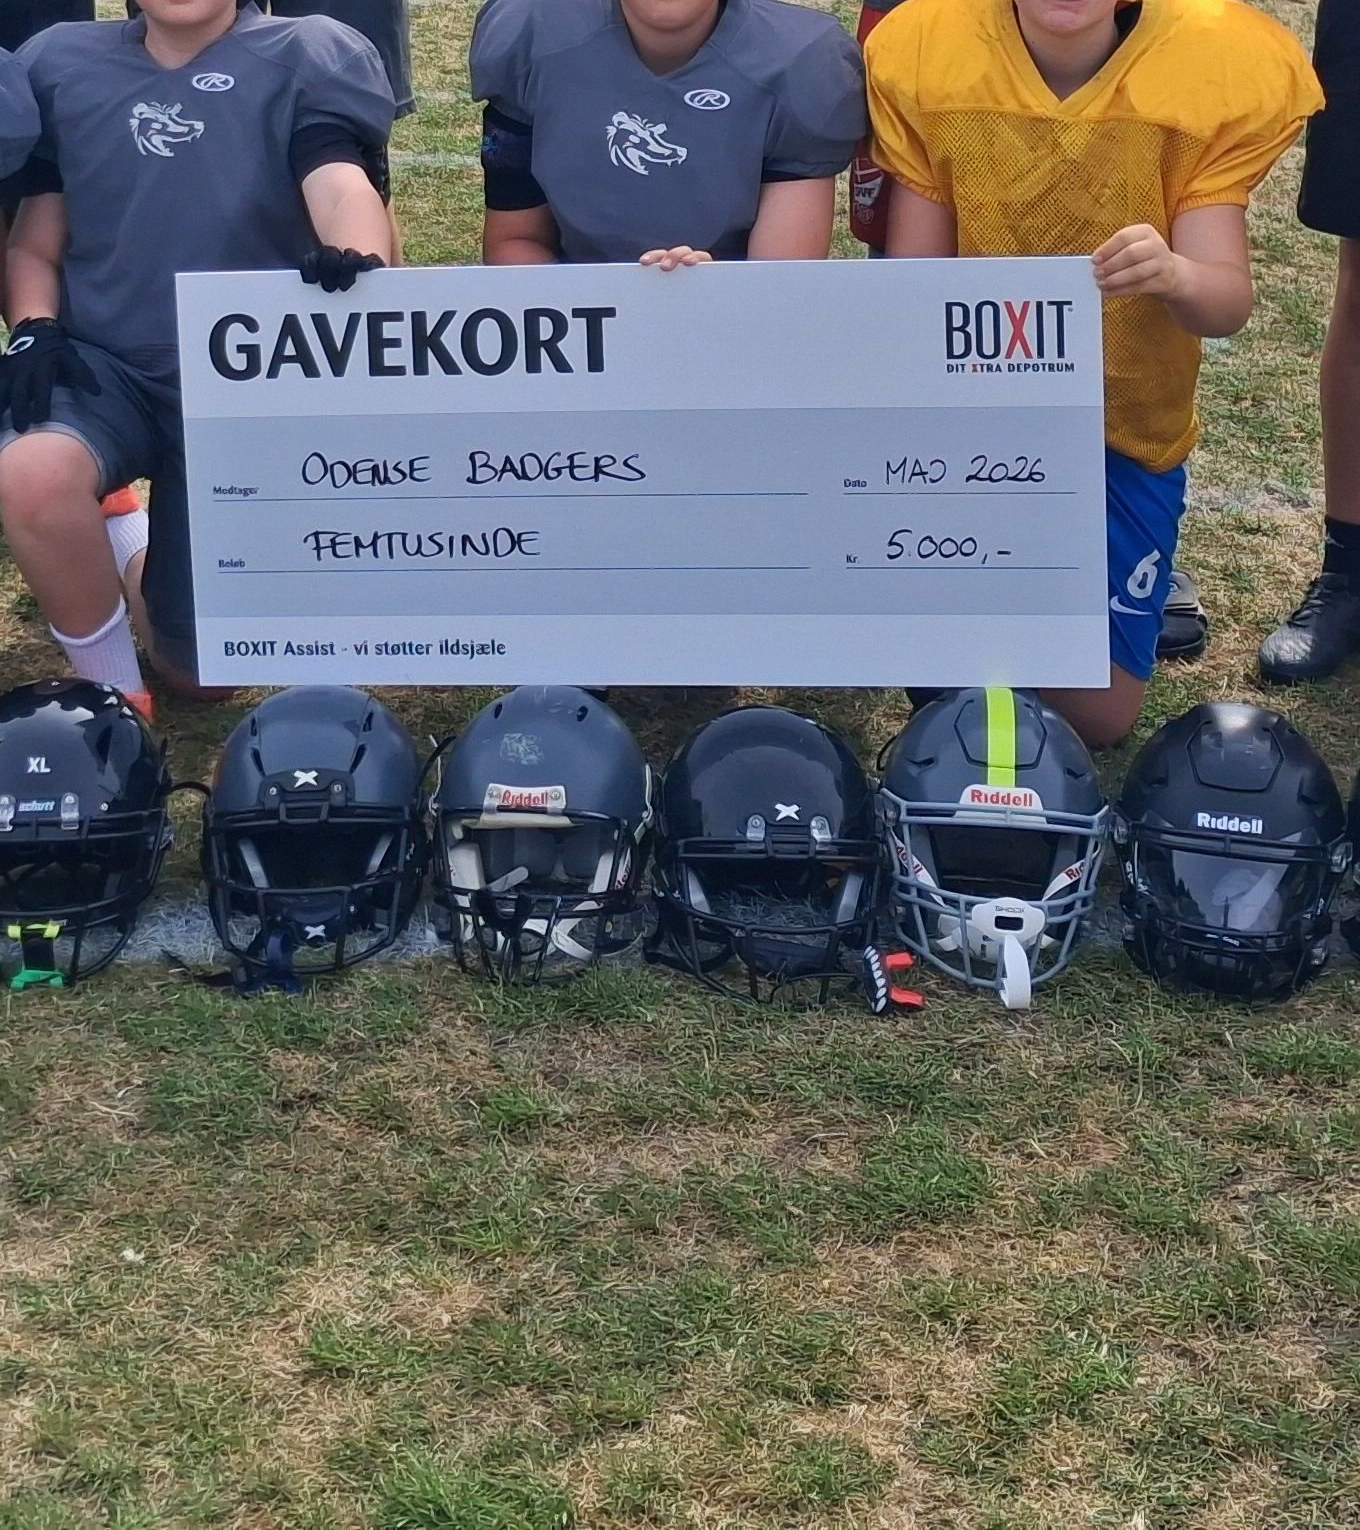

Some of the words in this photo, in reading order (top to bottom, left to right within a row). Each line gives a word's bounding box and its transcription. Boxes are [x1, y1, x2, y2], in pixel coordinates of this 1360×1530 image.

[945, 300, 1072, 359] BOXIT
[208, 307, 617, 381] GAVEKORT
[946, 363, 966, 373] DIT
[971, 363, 1002, 373] XTRA
[1007, 363, 1074, 373] DEPOTRUM
[302, 452, 431, 488] ODENSE
[466, 451, 646, 485] BADGERS
[886, 457, 946, 485] MAJ
[965, 455, 1045, 483] 2026
[303, 527, 540, 561] FEMTUSINDE
[224, 640, 277, 656] BOXIT
[283, 640, 336, 656] Assist
[353, 640, 368, 655] vi
[374, 640, 433, 656] støtter
[439, 639, 507, 659] ildsjæle
[27, 756, 51, 773] XL
[501, 790, 549, 806] Riddell
[970, 789, 1033, 806] Riddell
[1197, 812, 1263, 834] Riddell
